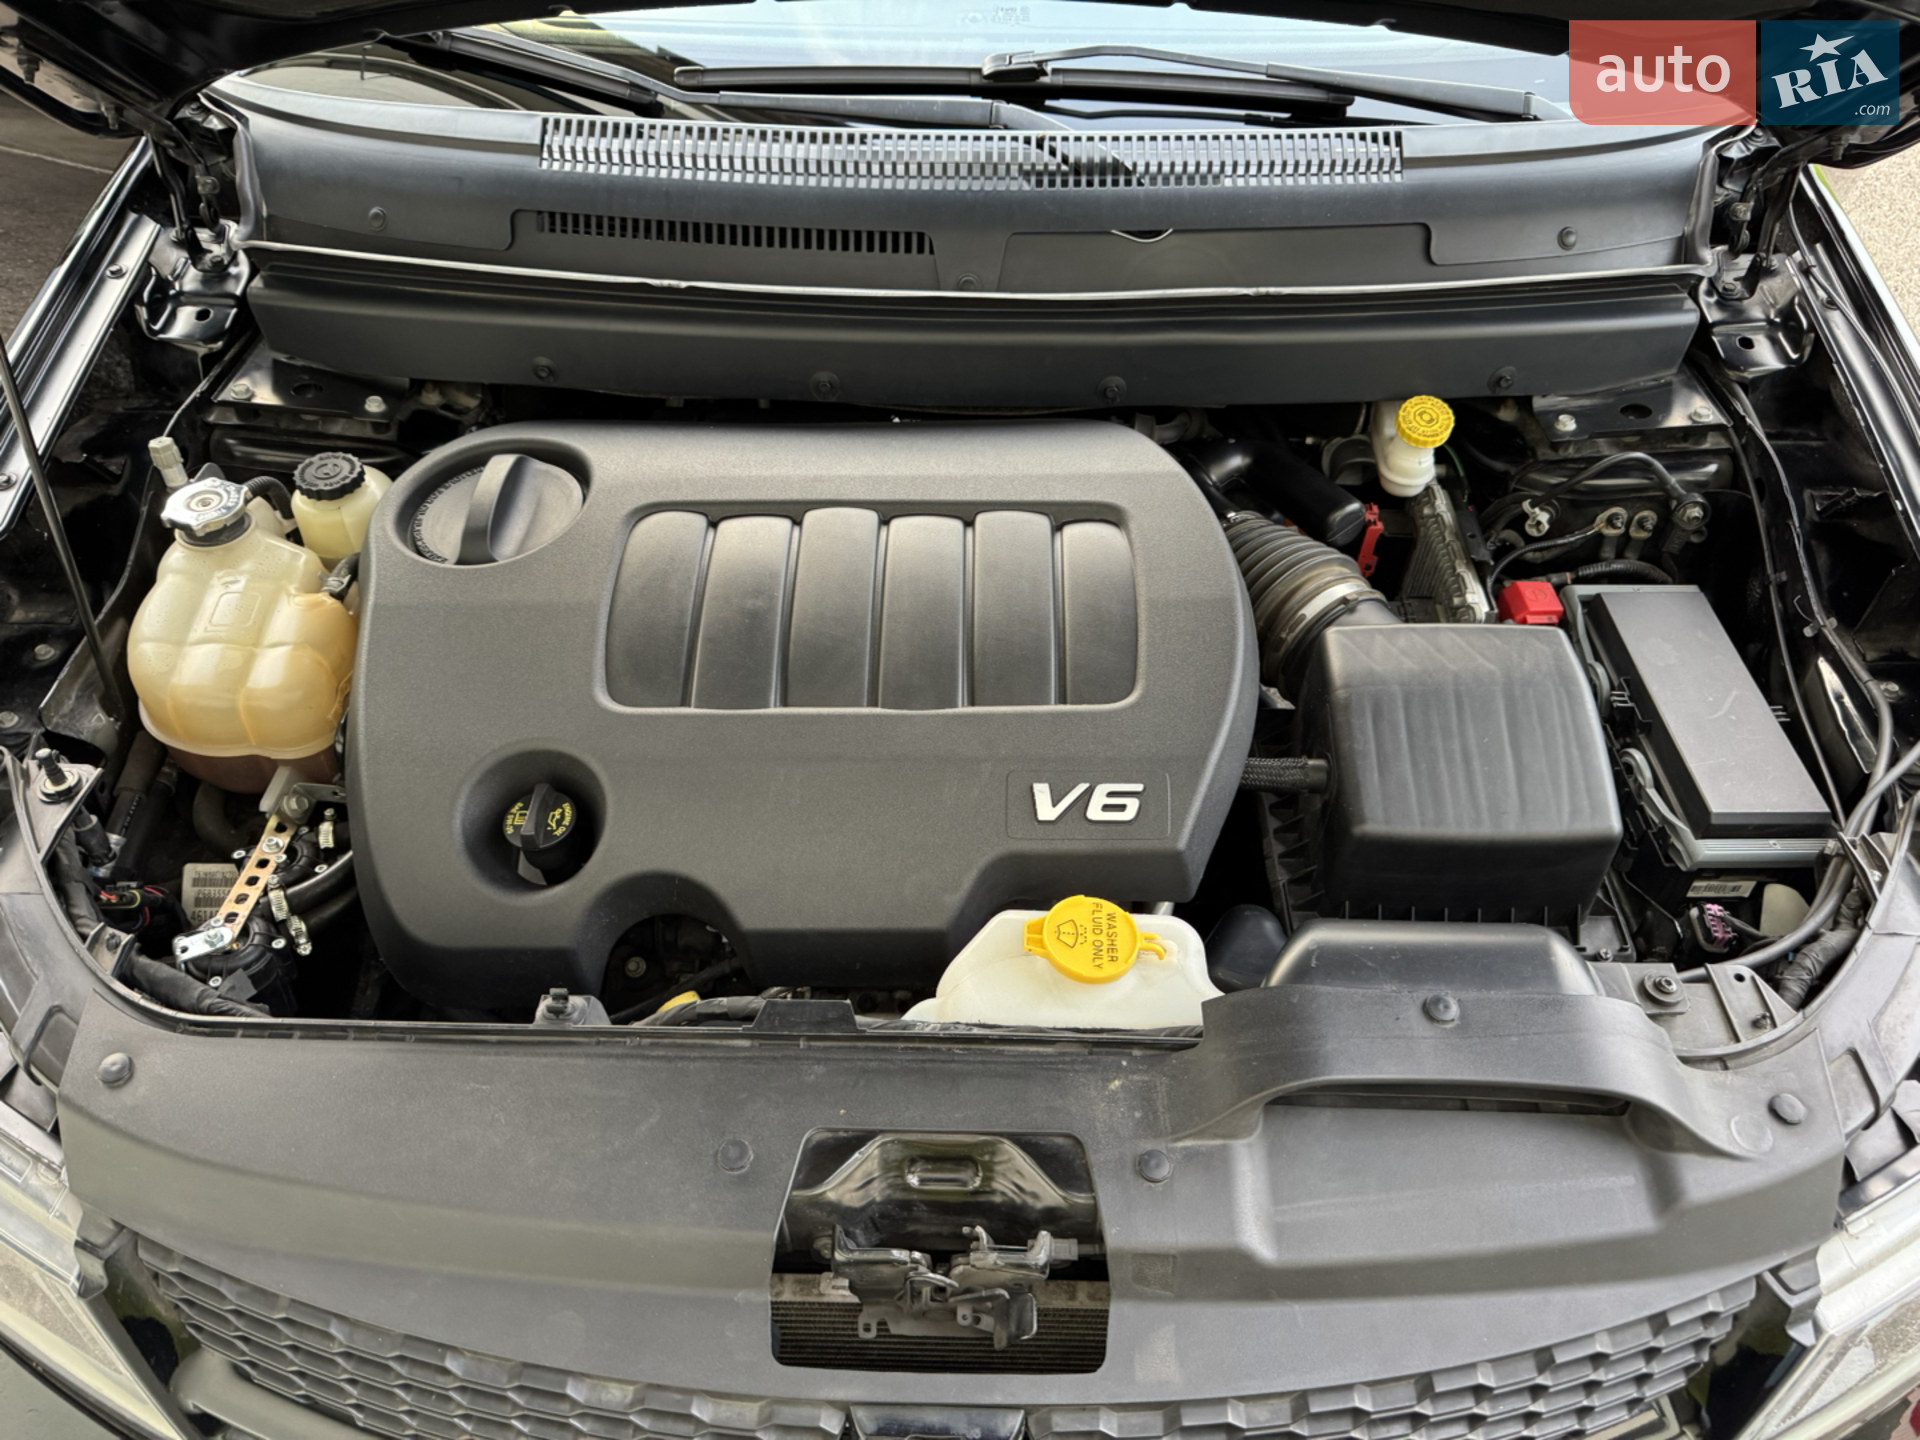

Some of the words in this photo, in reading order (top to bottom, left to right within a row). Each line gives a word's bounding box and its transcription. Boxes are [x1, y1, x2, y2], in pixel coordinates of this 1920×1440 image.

[562, 802, 572, 825] ENGINE
[1031, 782, 1145, 823] V6
[552, 826, 566, 836] OIL
[1091, 902, 1104, 936] FLUID
[1106, 912, 1119, 963] WASHER
[1091, 939, 1104, 969] ONLY
